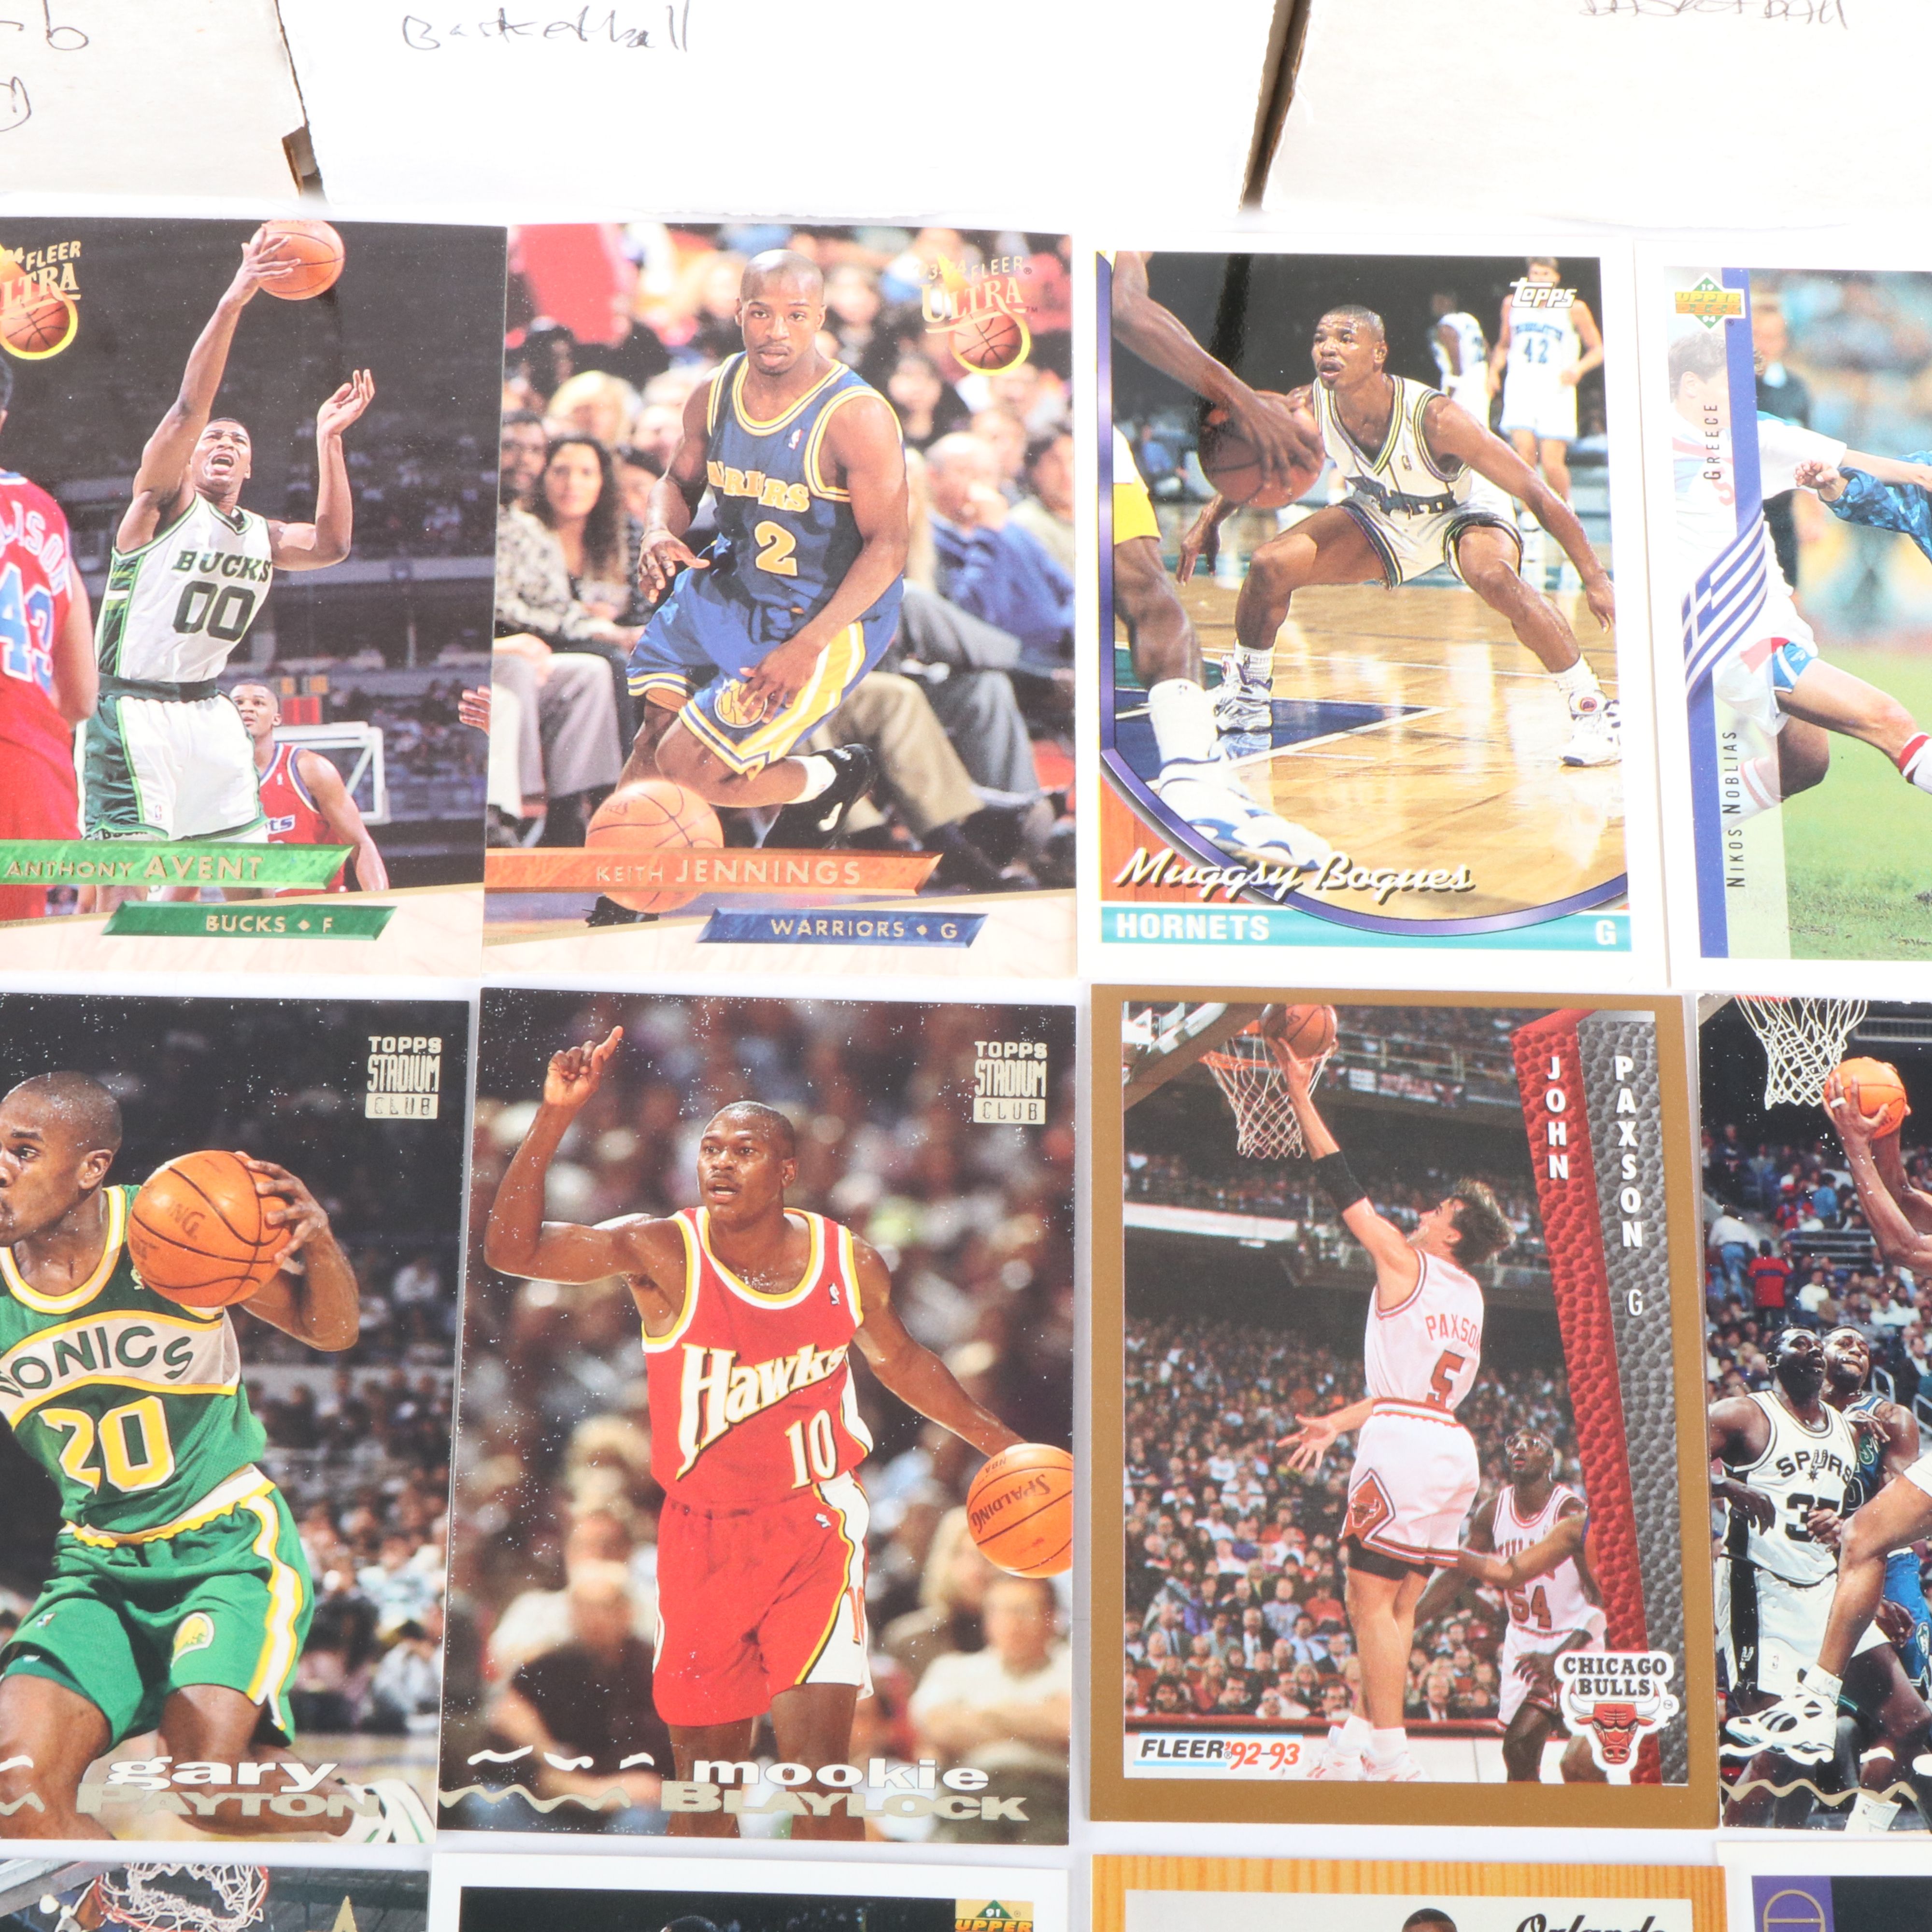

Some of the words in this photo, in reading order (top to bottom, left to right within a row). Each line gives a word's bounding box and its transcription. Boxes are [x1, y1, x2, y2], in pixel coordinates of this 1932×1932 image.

[26, 241, 81, 271] FLEER
[971, 256, 1023, 282] FLEER
[920, 277, 1023, 323] ULTRA
[1675, 292, 1741, 303] UPPER
[1676, 303, 1742, 314] DECK
[1703, 404, 1721, 480] GREECE
[754, 521, 798, 576] 2
[171, 550, 272, 582] BUCKS
[172, 580, 256, 641] 00
[1722, 732, 1741, 814] NOBLIAS
[6, 861, 134, 877] ANTHONY
[144, 855, 263, 881] AVENT
[596, 865, 665, 883] KEITH
[676, 859, 861, 885] JENNINGS
[1726, 829, 1746, 888] NIKOS
[1113, 847, 1304, 902] Muggsy
[1312, 852, 1475, 904] Bogues
[206, 914, 286, 933] BUCKS
[323, 917, 333, 933] F
[771, 919, 905, 938] WARRIORS
[940, 923, 958, 939] G
[1116, 913, 1270, 941] HORNETS
[1595, 919, 1616, 945] G
[368, 1036, 442, 1054] TOPPS
[974, 1041, 1048, 1059] TOPPS
[367, 1054, 440, 1093] STADIUM
[974, 1059, 1047, 1097] STADIUM
[374, 1096, 430, 1115] CLUB
[983, 1101, 1037, 1120] CLUB
[1546, 1056, 1569, 1179] JOHN
[1614, 1055, 1643, 1248] PAXSON
[1628, 1289, 1643, 1316] G
[1426, 1349, 1465, 1408] 5
[675, 1342, 850, 1480] Hawks
[38, 1395, 176, 1495] 20
[784, 1409, 836, 1490] 10
[1563, 1656, 1667, 1677] CHICAGO
[1578, 1677, 1651, 1697] BULLS
[1140, 1739, 1224, 1759] FLEER
[1224, 1741, 1300, 1770] '92-93
[106, 1756, 339, 1793] gary
[693, 1758, 989, 1790] mookie
[76, 1782, 380, 1818] PAYTON
[661, 1780, 1030, 1821] BLAYLOCK
[955, 1920, 1033, 1932] UPPER
[985, 1908, 1001, 1918] 91
